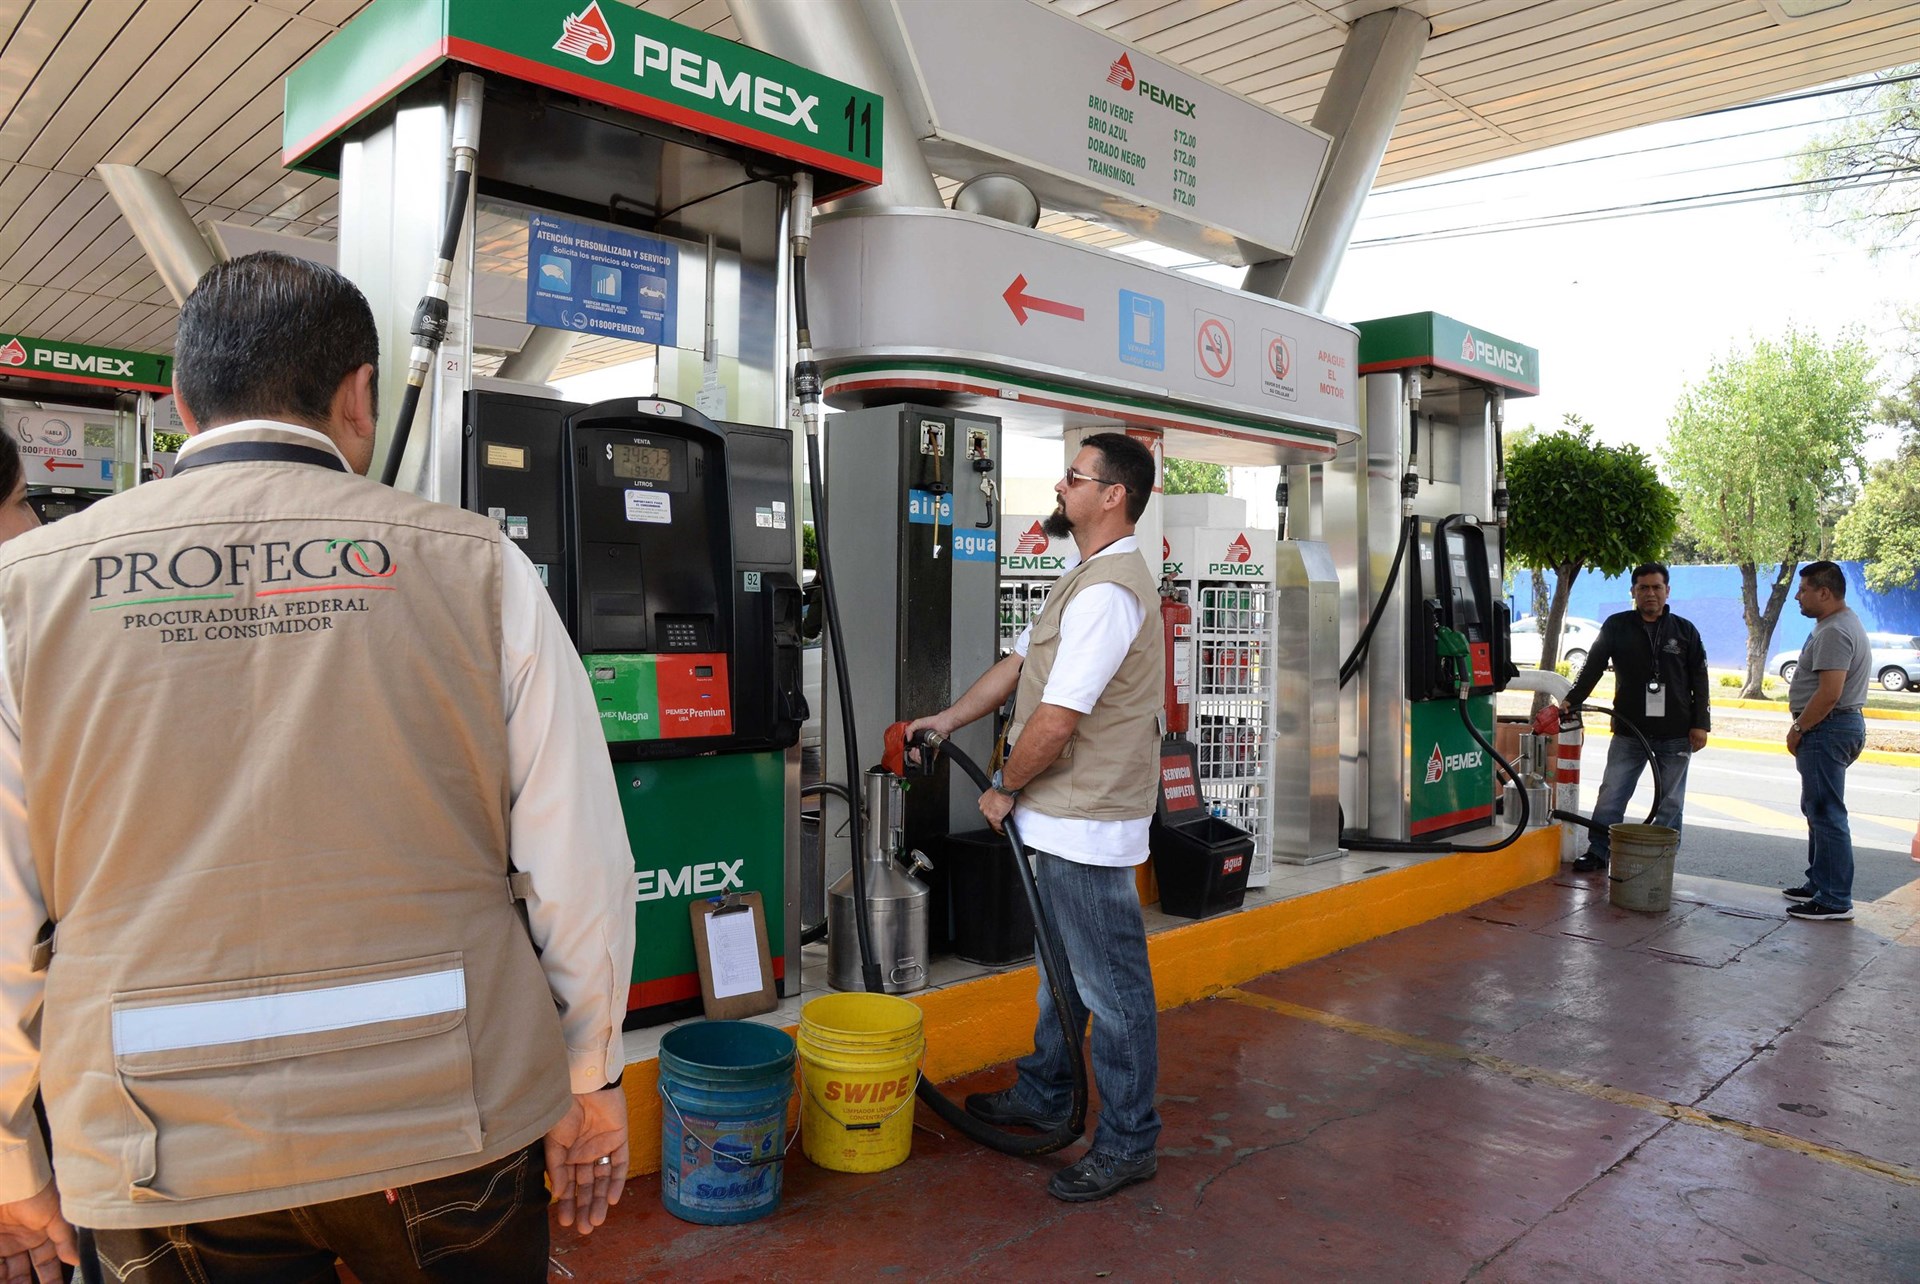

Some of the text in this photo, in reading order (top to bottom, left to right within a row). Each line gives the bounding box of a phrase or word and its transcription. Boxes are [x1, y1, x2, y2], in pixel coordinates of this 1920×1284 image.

[633, 34, 820, 134] PEMEX
[1088, 95, 1134, 124] BRIO VERDE
[1138, 79, 1196, 120] PEMEX
[844, 95, 872, 158] 11
[1088, 115, 1128, 142] BRIO AZUL
[1088, 136, 1146, 170] DORADO NEGRO
[1088, 157, 1136, 186] TRANSMISOL
[540, 220, 559, 229] PEMEX
[537, 230, 574, 246] ATENCIÓN
[575, 239, 632, 258] PERSONALIZADA
[639, 252, 671, 266] SERVICIO
[552, 245, 578, 257] Solicita
[591, 254, 620, 266] servicios
[589, 318, 645, 335] 01800PEMEX00
[34, 348, 134, 377] PEMEX
[447, 360, 458, 371] 21
[1318, 351, 1346, 368] APAGUE
[1475, 339, 1524, 376] PEMEX
[156, 359, 166, 383] 7
[1327, 369, 1337, 381] EL
[1319, 383, 1345, 400] MOTOR
[791, 408, 800, 417] 22
[18, 445, 77, 457] 1800PEMEX00
[633, 438, 651, 446] VENTA
[633, 480, 654, 488] LITROS
[909, 496, 950, 518] aire
[954, 535, 996, 555] agua
[89, 538, 391, 600] PROFECO
[1209, 563, 1264, 576] PEMEX
[747, 573, 758, 586] 92
[123, 598, 369, 629] PROCURADURÍA FEDERAL
[160, 617, 333, 643] DEL CONSUMIDOR
[600, 711, 649, 723] MEX Magna
[665, 707, 726, 718] PEMEX Premium
[1445, 751, 1483, 773] PEMEX
[1163, 766, 1191, 781] SERVICIO
[1164, 784, 1196, 799] COMPLETO
[1223, 856, 1243, 871] agua
[635, 858, 744, 902] EMEX
[824, 1075, 910, 1104] SWIPE
[761, 1131, 772, 1151] 6
